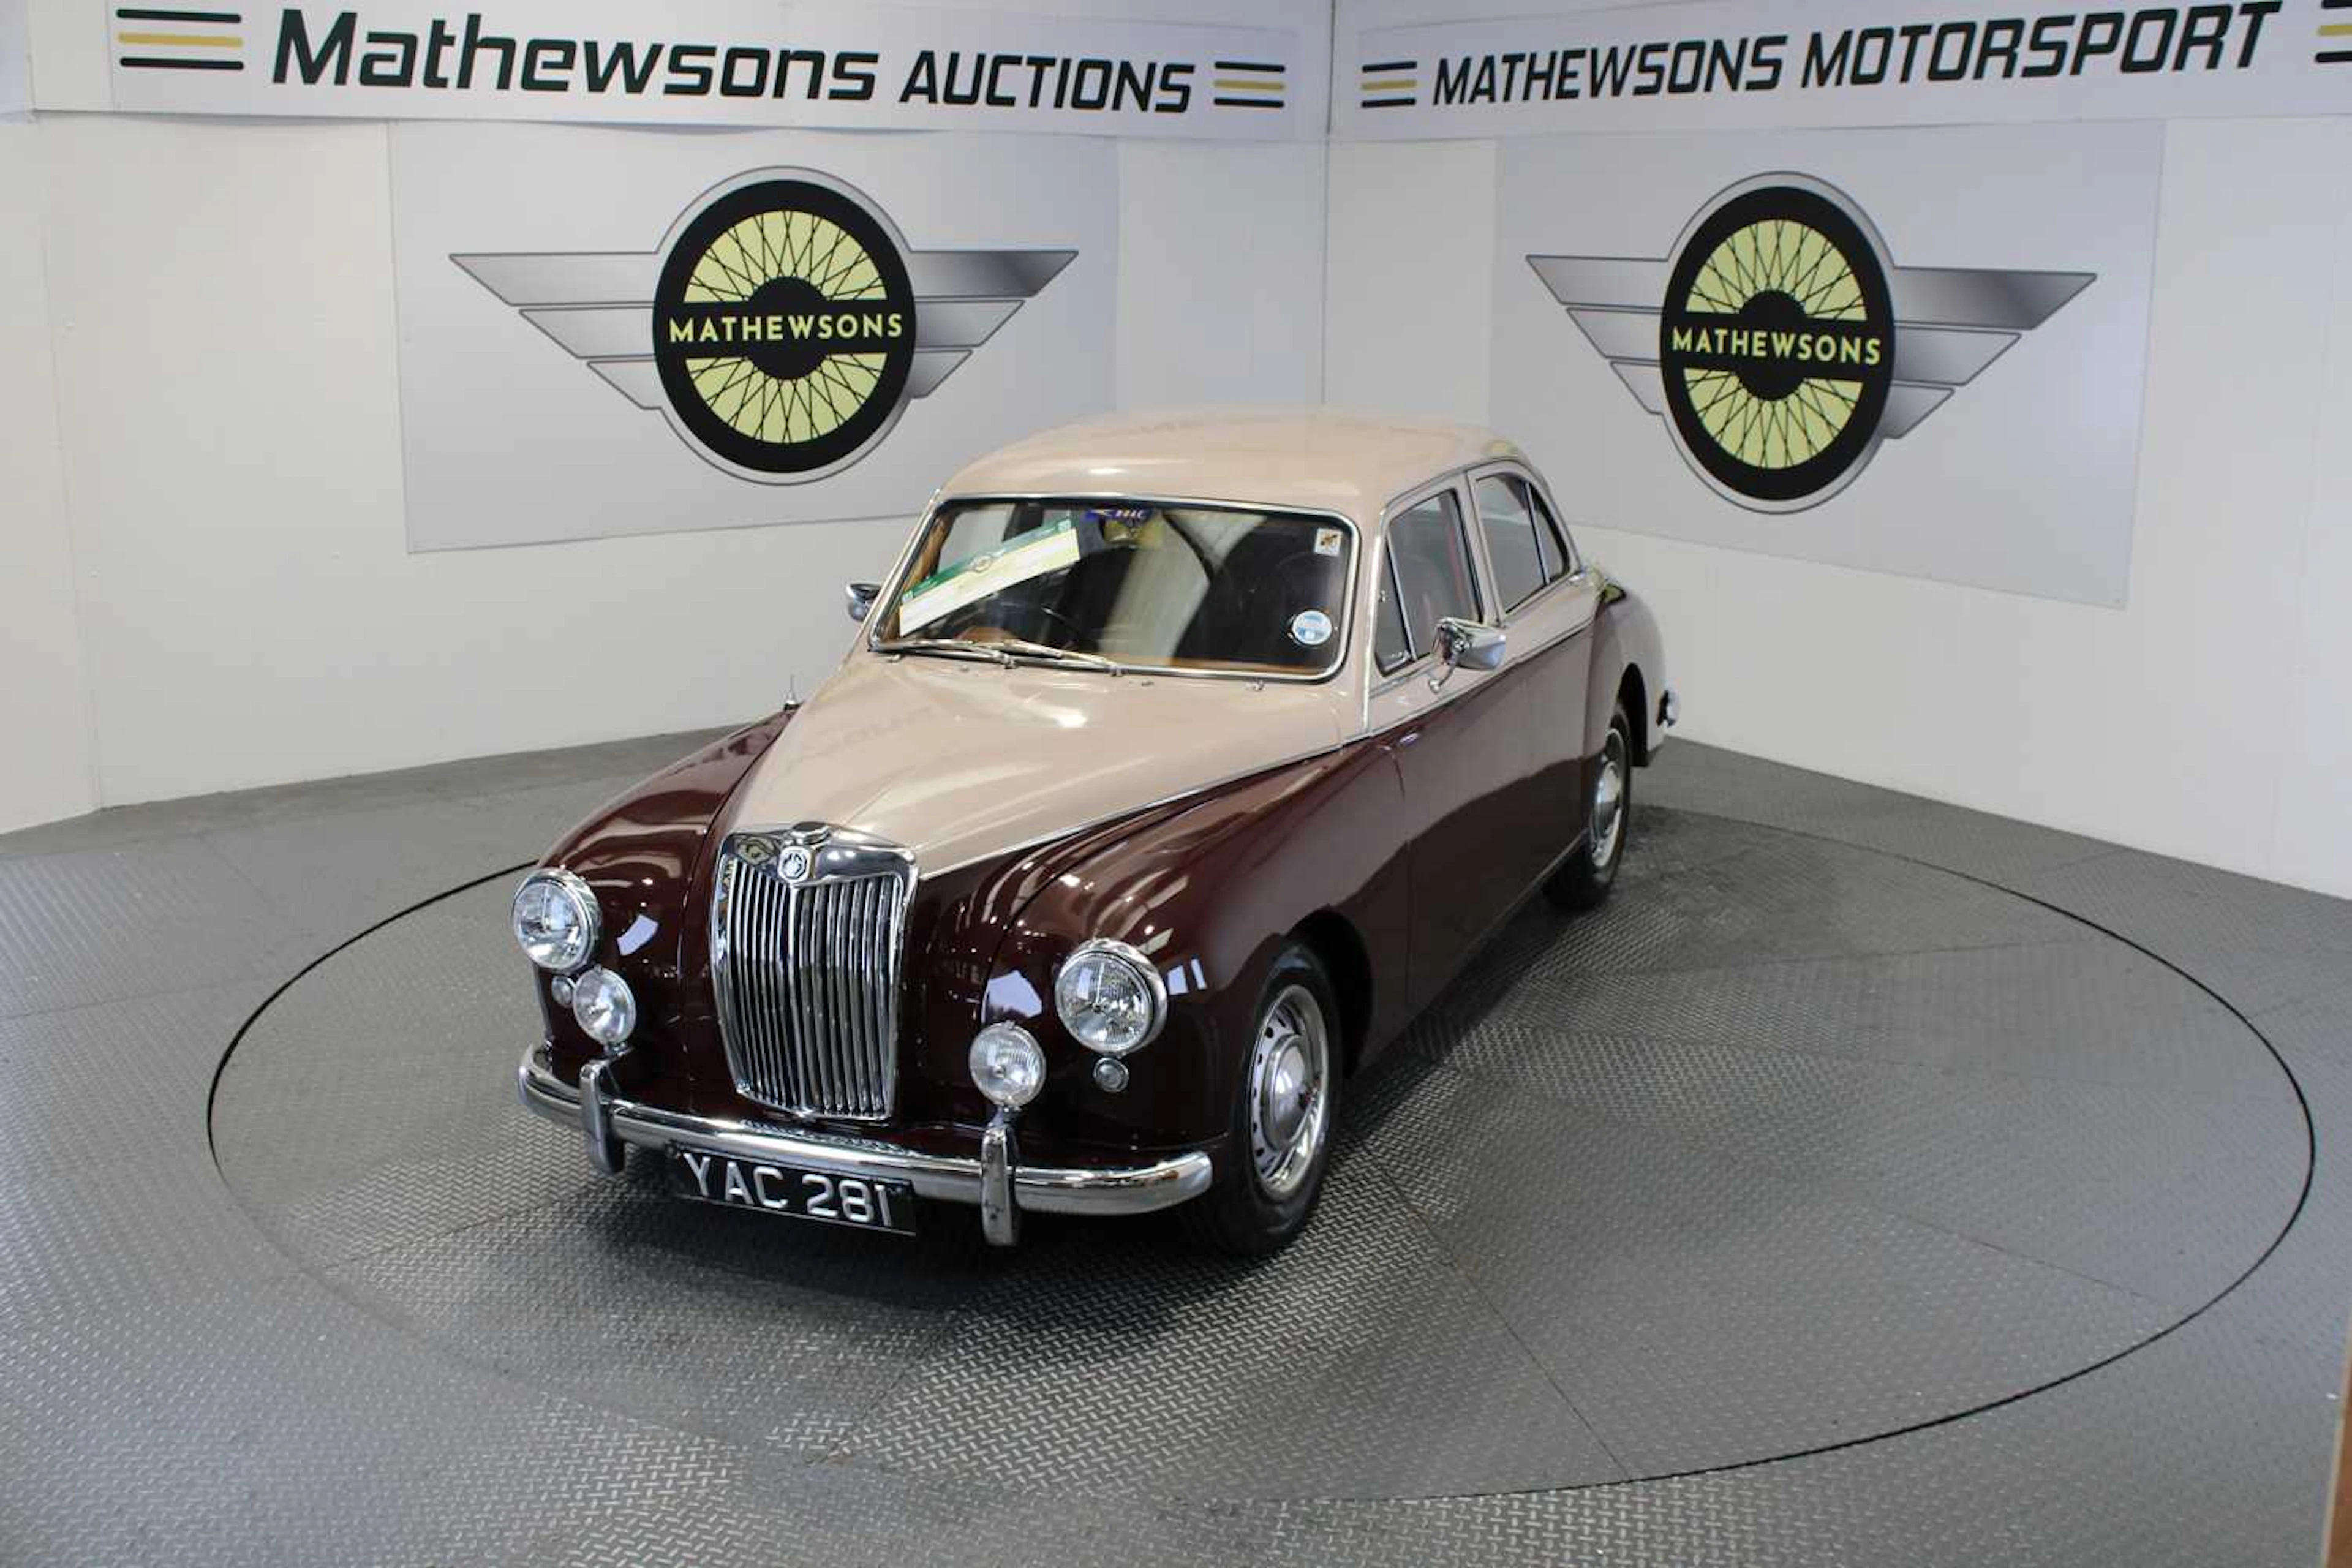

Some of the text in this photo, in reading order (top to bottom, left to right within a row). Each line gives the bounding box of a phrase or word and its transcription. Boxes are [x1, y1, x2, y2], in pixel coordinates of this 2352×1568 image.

[273, 10, 1196, 113] Mathewsons AUCTIONS
[1433, 2, 2283, 105] MATHEWSONS MOTORSPORT
[670, 314, 902, 343] MATHEWSONS
[1673, 328, 1880, 365] MATHEWSONS
[683, 1153, 892, 1227] YAC 281
